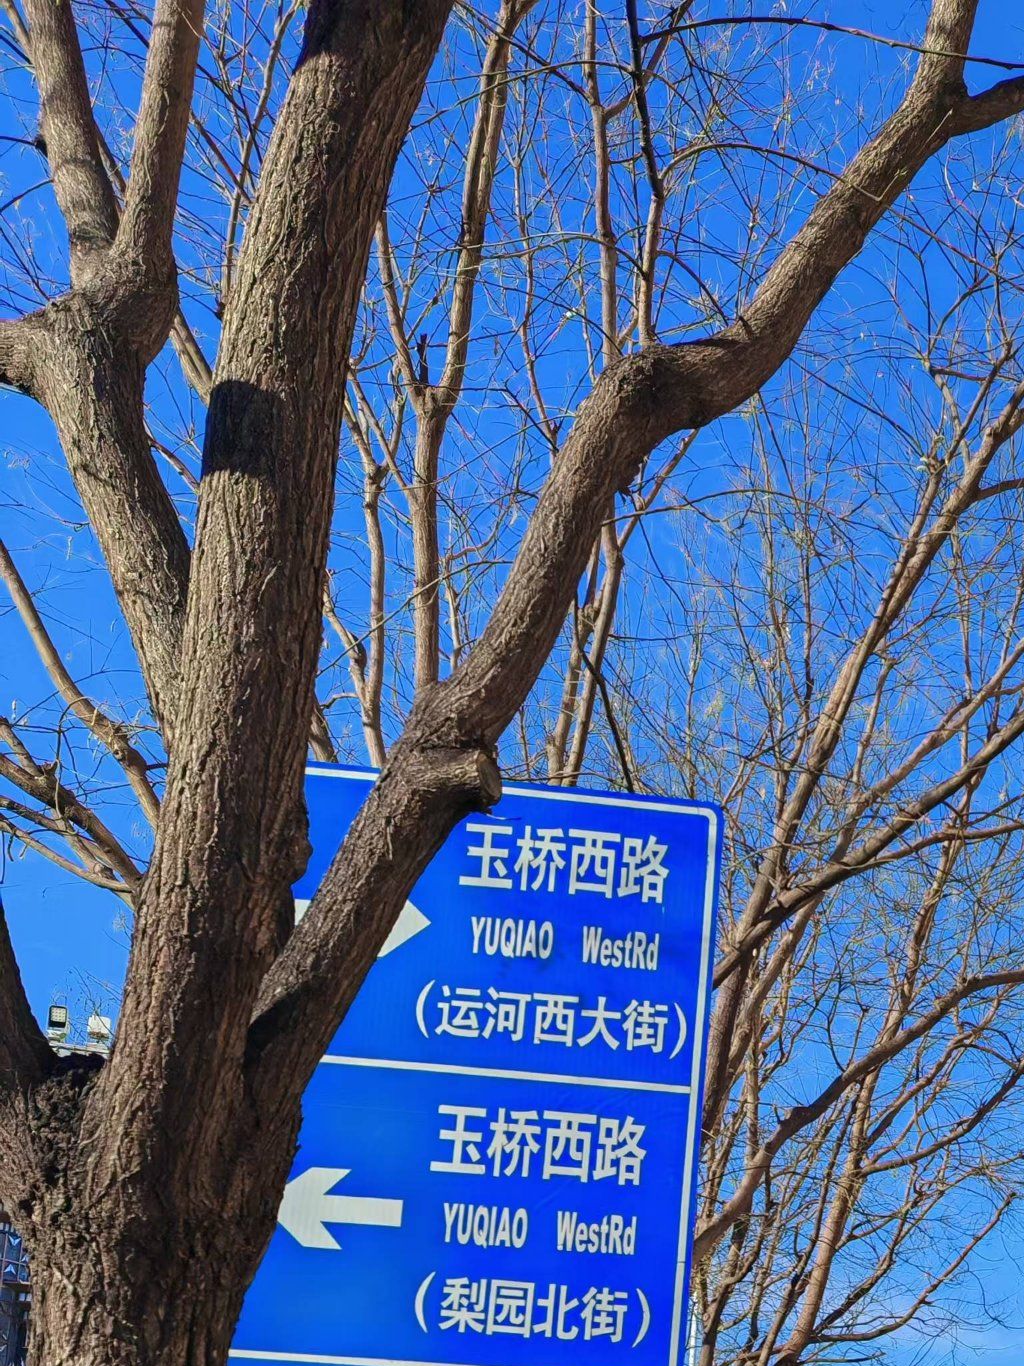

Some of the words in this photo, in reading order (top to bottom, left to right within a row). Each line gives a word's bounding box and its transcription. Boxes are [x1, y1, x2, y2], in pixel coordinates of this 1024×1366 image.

[459, 823, 669, 904] 玉桥西路
[471, 916, 554, 960] YUQIAO
[581, 926, 660, 971] WestRd
[415, 980, 687, 1060] （运河西大街）
[430, 1104, 647, 1186] 玉桥西路
[443, 1203, 529, 1249] YUQIAO
[556, 1211, 637, 1256] WestRd
[414, 1272, 651, 1348] （梨园北街）
